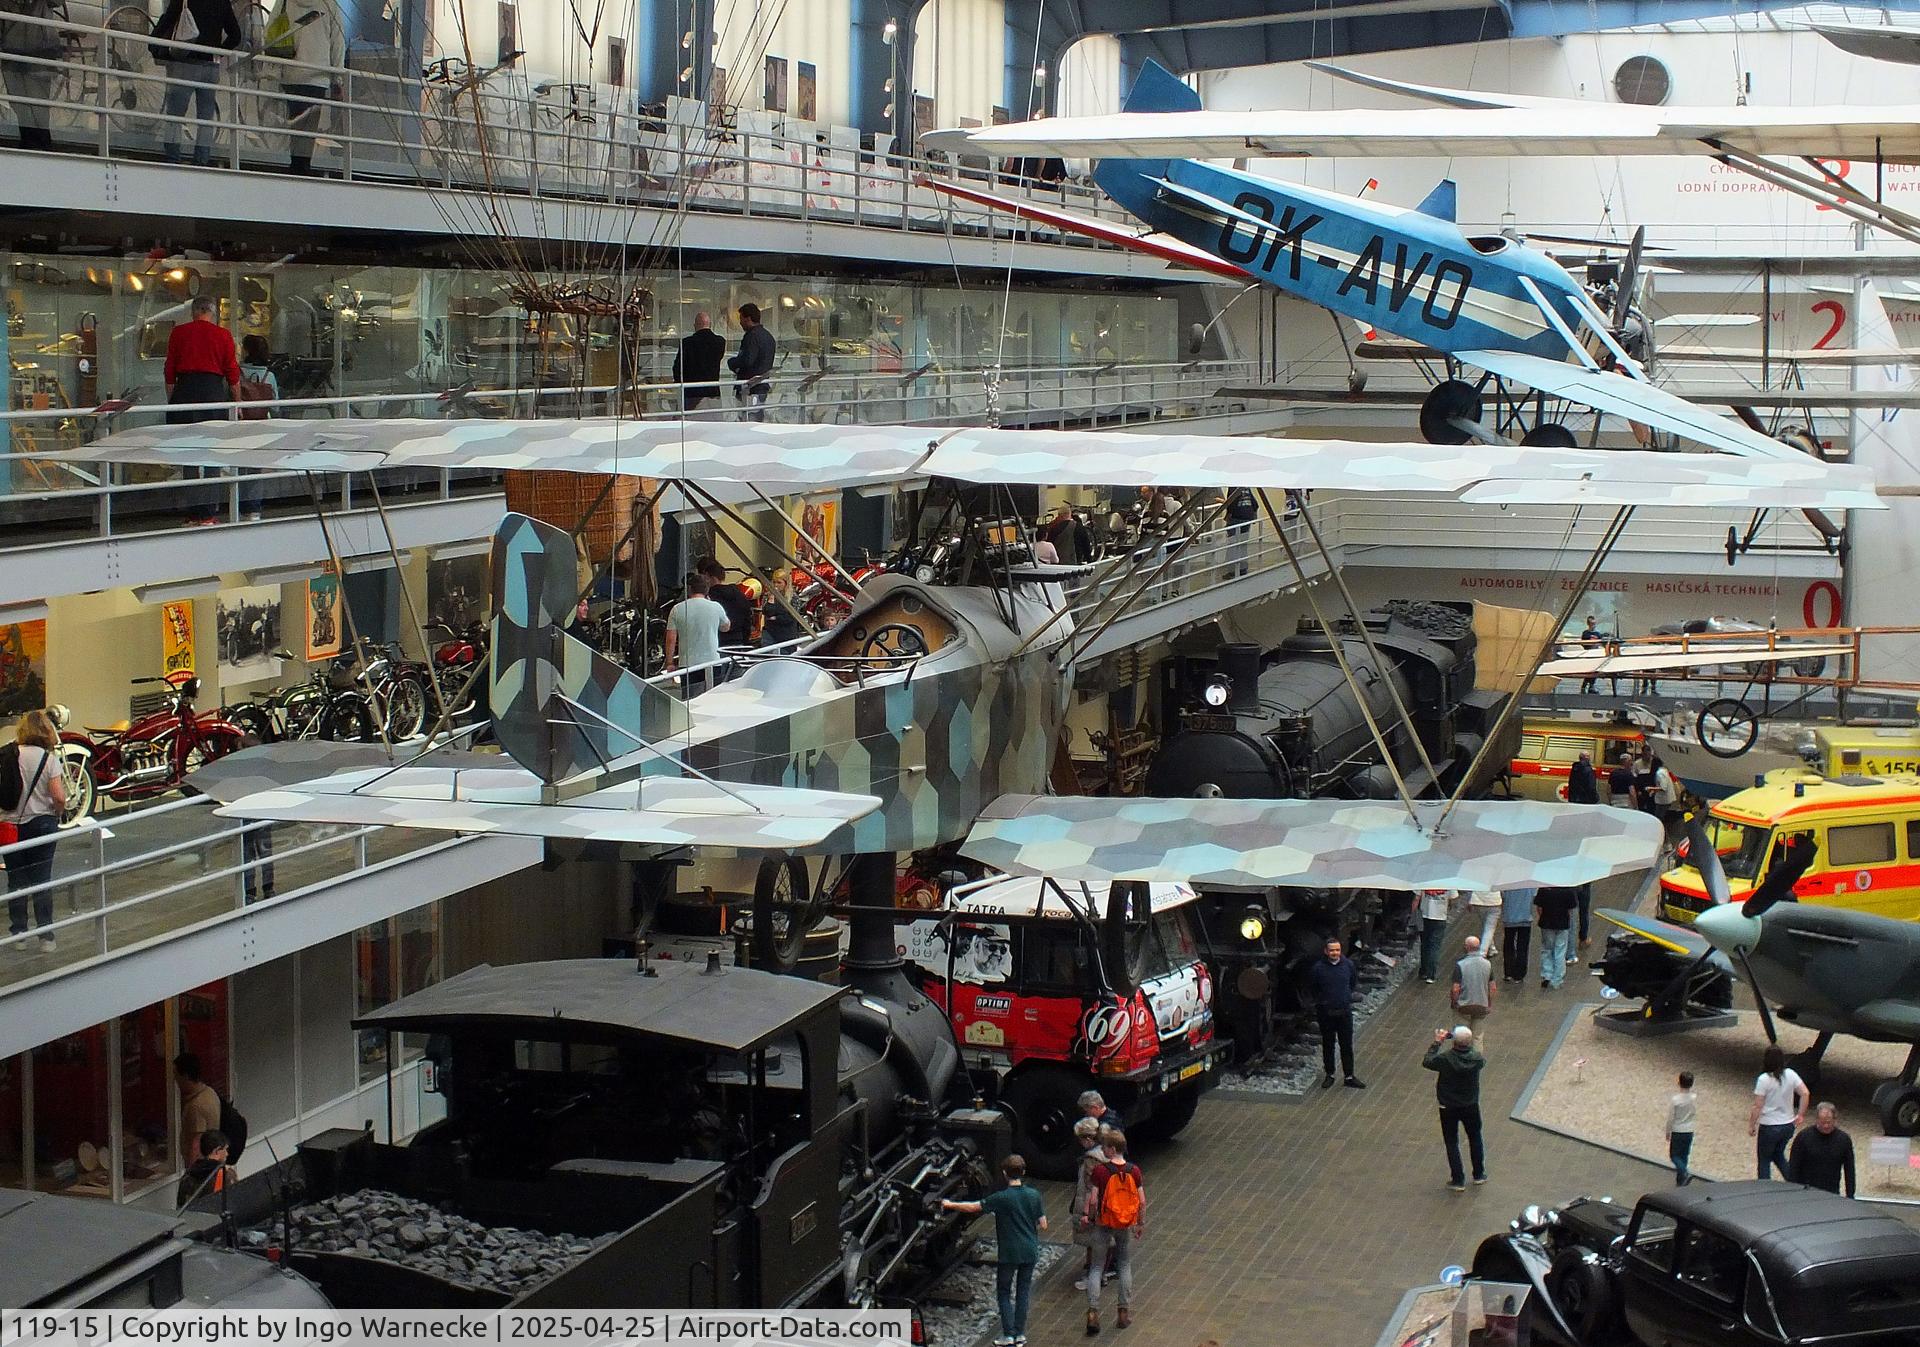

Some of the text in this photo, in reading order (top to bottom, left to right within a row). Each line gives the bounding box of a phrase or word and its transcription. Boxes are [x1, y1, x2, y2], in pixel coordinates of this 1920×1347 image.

[1677, 180, 1717, 193] LODNÍ
[1218, 192, 1473, 330] OK-AVO
[1811, 300, 1847, 350] 2
[1460, 577, 1780, 596] AUTOMOBILY ŽEZNICE HASIČSKÁ TECHNIKA
[967, 904, 1006, 915] TATRA
[976, 998, 1010, 1010] OPTIMA
